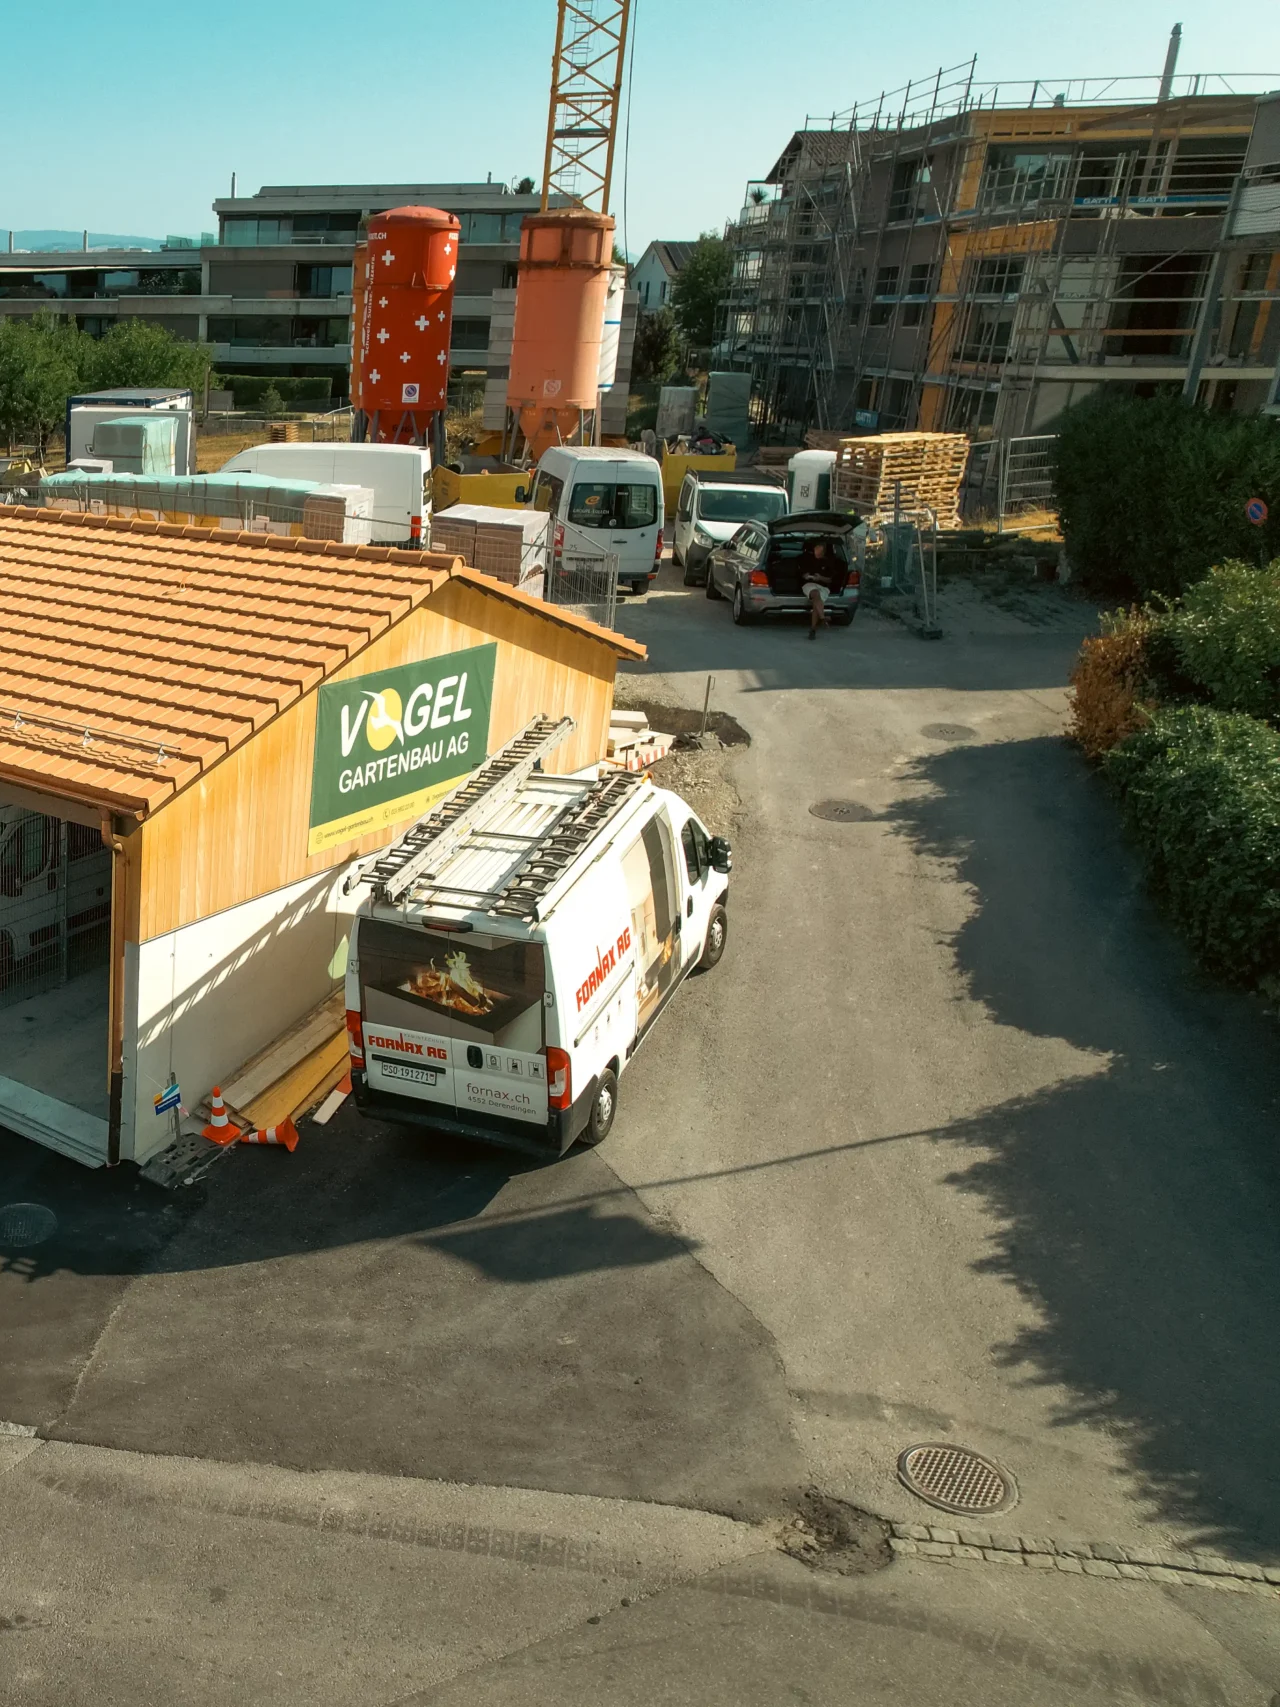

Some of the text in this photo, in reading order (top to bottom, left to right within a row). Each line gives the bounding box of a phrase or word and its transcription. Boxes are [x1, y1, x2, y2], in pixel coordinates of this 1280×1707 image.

[340, 672, 472, 758] VOGEL
[338, 731, 469, 793] GARTENBAU AG
[575, 926, 631, 1012] FORNAX AG
[368, 1032, 447, 1060] FORNAX AG
[388, 1065, 429, 1082] SO 191271
[467, 1083, 530, 1104] fornax.ch
[488, 1099, 537, 1115] Derendingen
